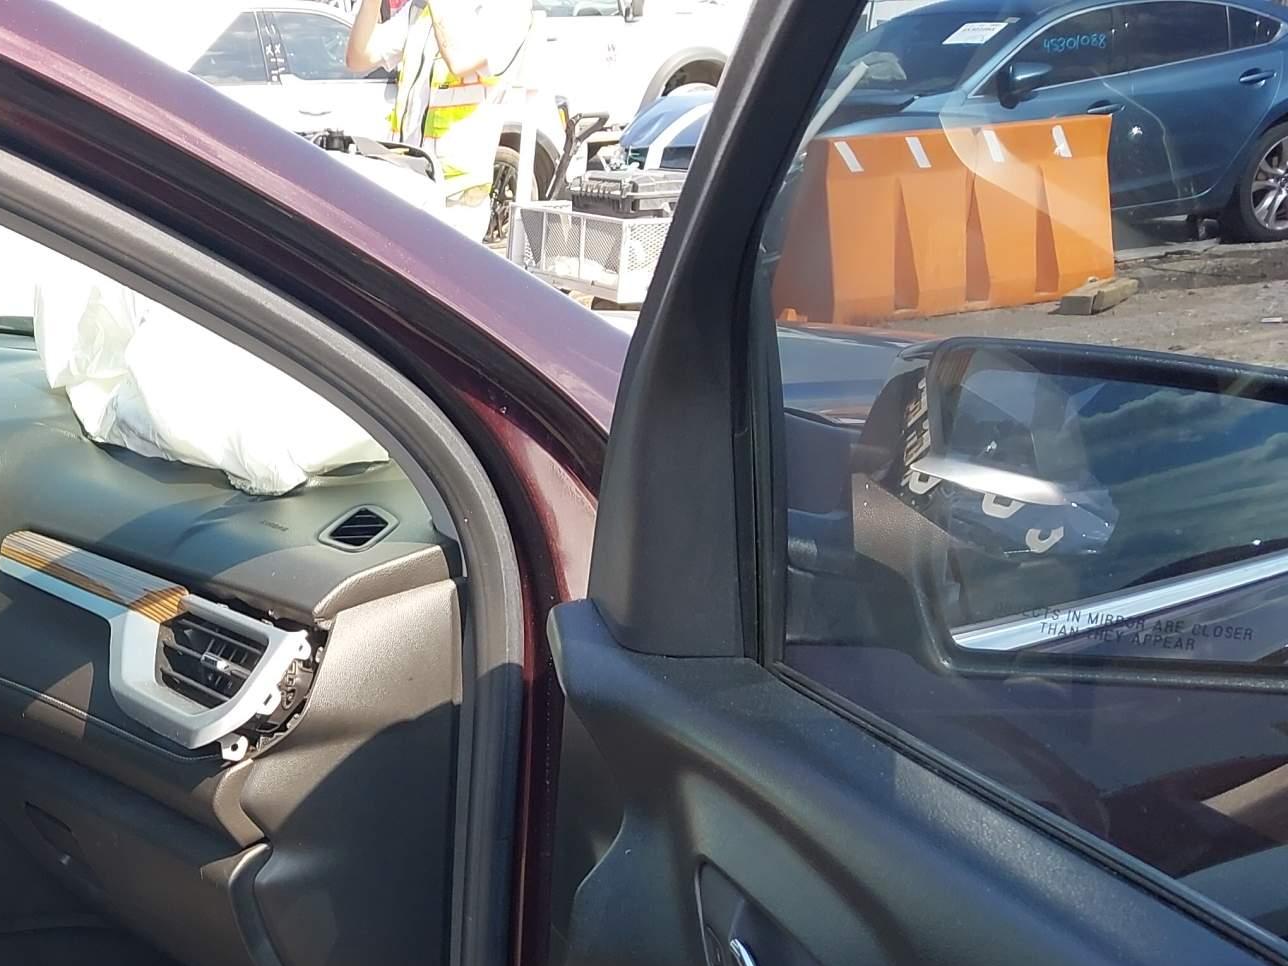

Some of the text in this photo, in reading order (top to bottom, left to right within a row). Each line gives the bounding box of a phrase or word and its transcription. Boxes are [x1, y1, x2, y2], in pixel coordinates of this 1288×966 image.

[1039, 621, 1080, 636] THAN
[1066, 610, 1082, 623] IN
[1152, 619, 1185, 633] ARE
[1192, 623, 1254, 641] CLOSER
